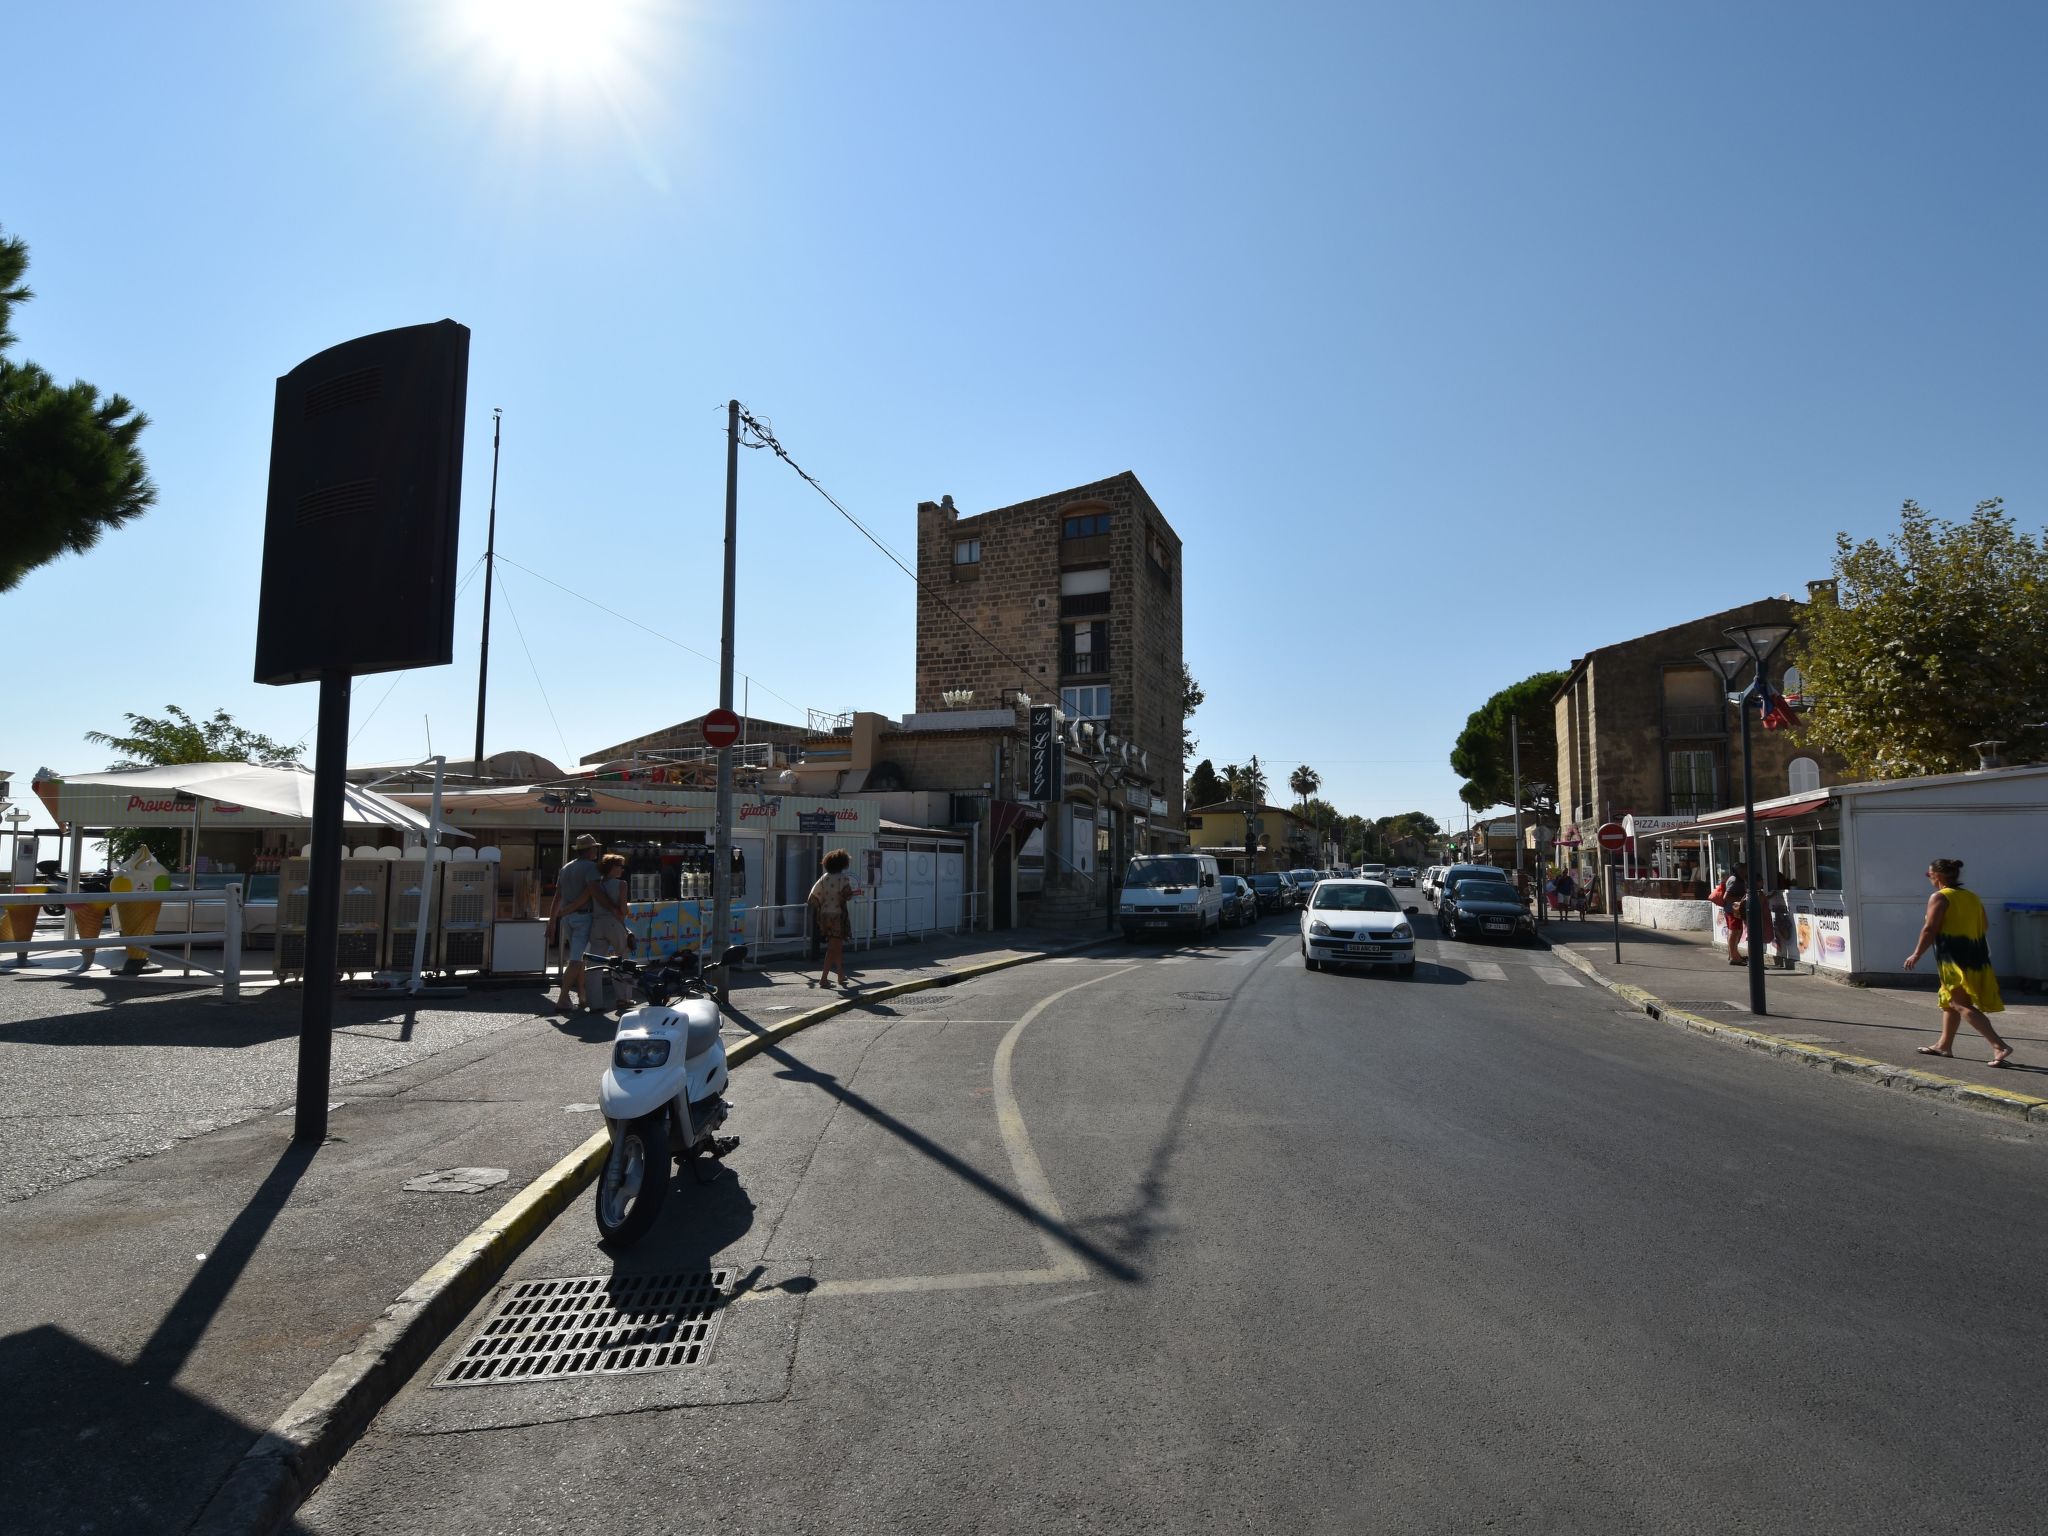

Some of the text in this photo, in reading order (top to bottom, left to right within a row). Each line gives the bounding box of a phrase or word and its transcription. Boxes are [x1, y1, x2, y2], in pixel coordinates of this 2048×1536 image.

[1033, 712, 1049, 726] Le
[1032, 732, 1050, 795] Label
[128, 795, 196, 811] Provence
[1633, 819, 1660, 829] PIZZA
[1819, 920, 1840, 931] CHAUDS
